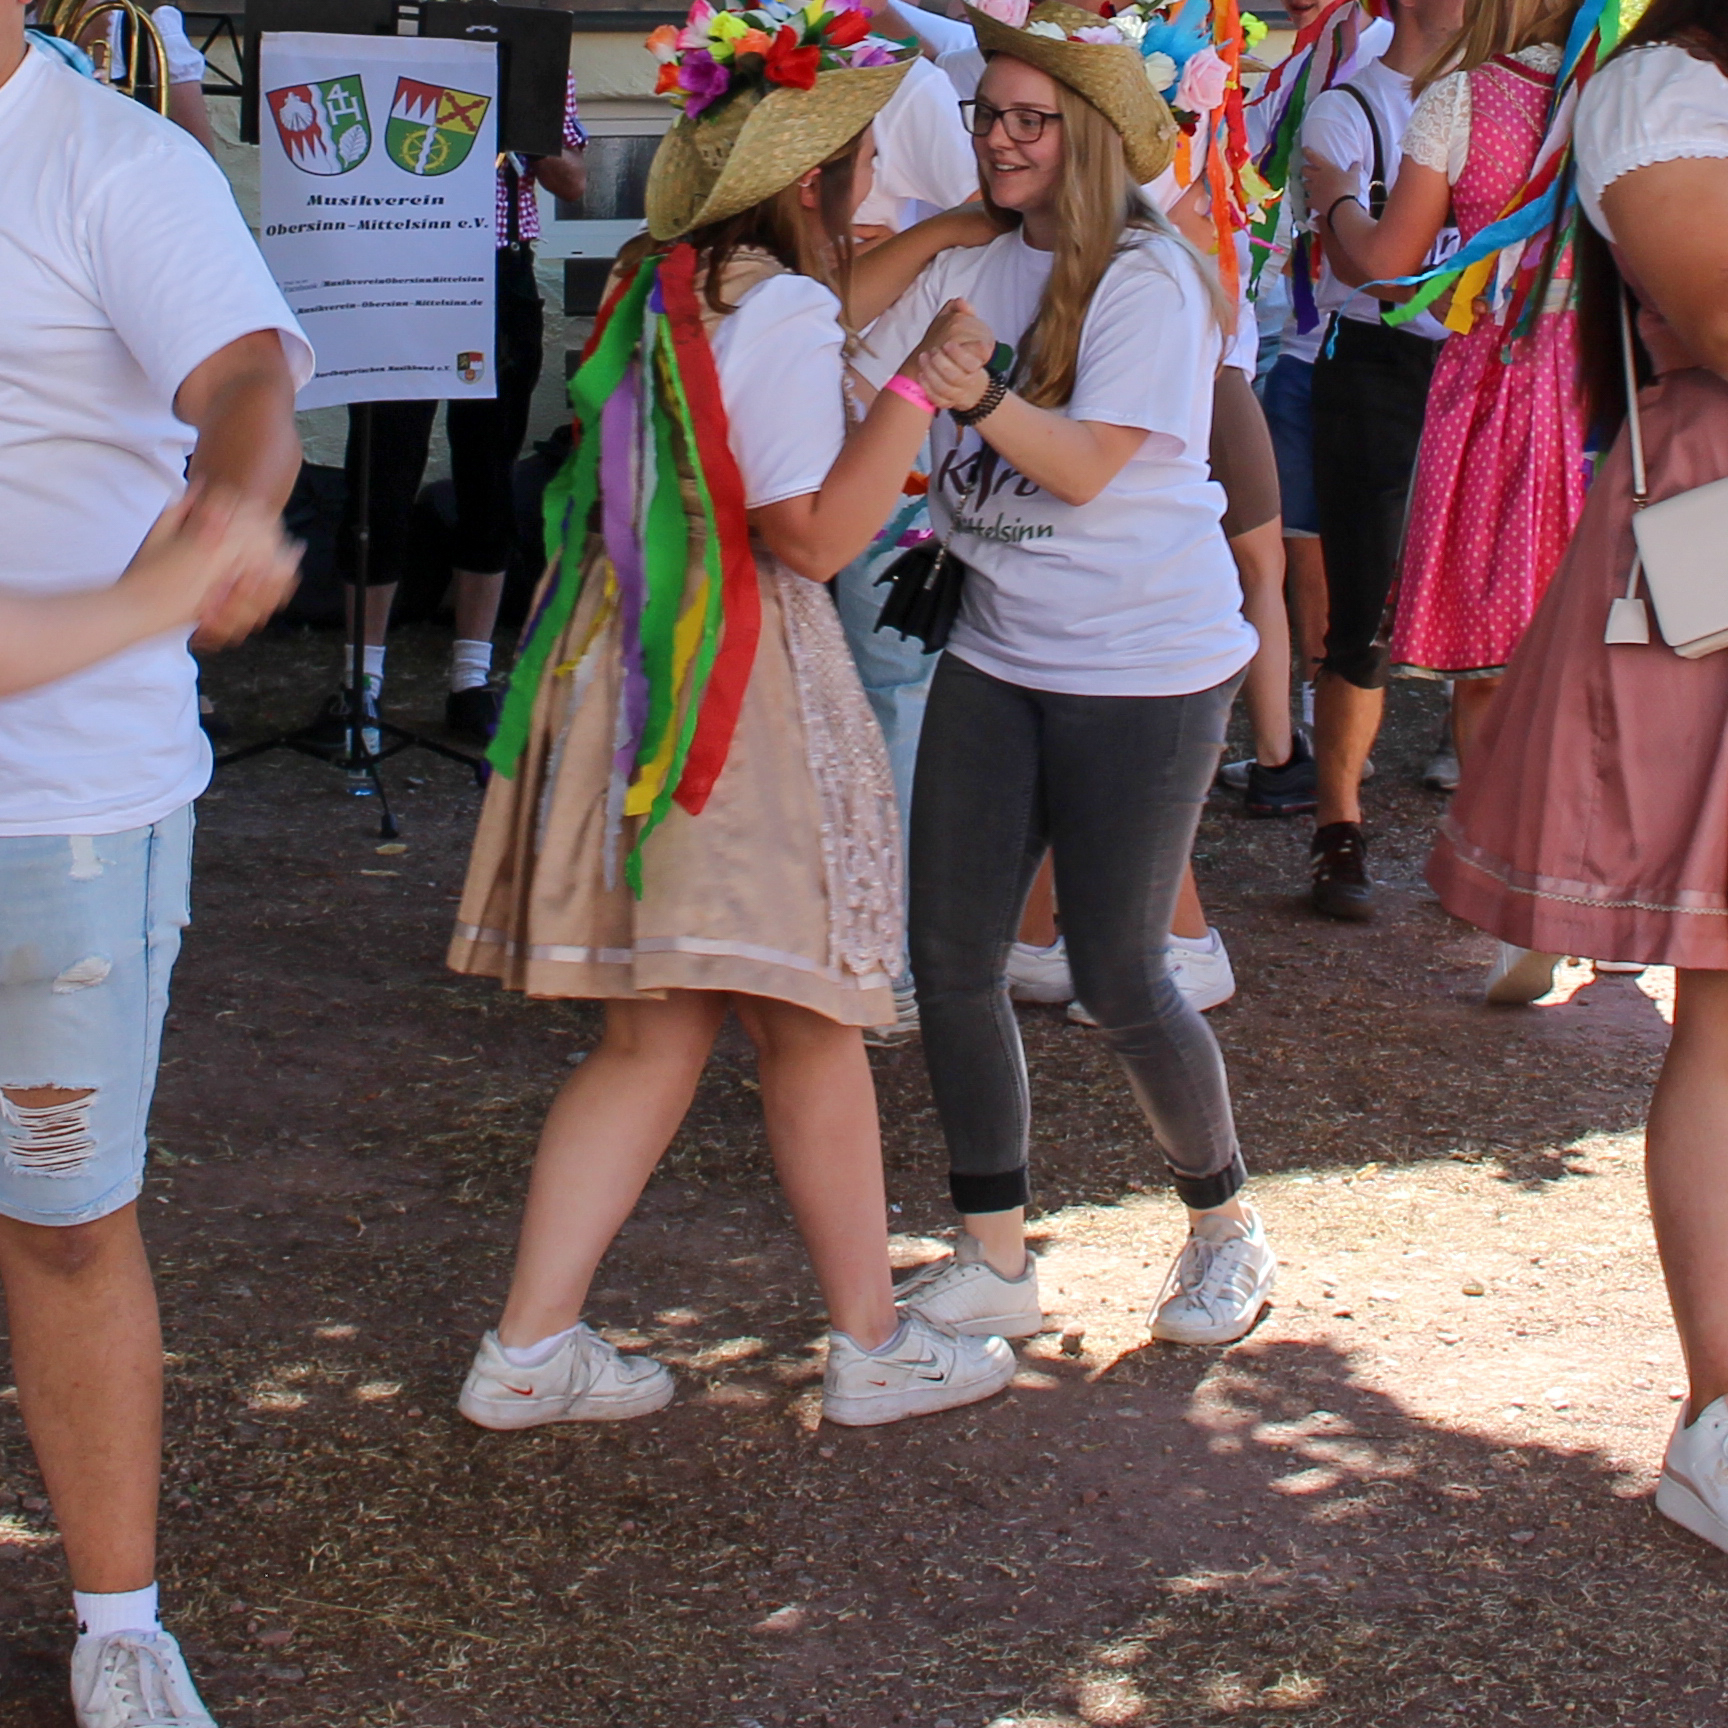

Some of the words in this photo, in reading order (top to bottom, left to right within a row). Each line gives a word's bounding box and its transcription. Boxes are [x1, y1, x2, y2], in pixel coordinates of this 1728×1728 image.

[306, 193, 445, 207] Musikverein
[265, 218, 452, 237] Obersinn-Mittelsinn
[457, 217, 489, 229] e.V.
